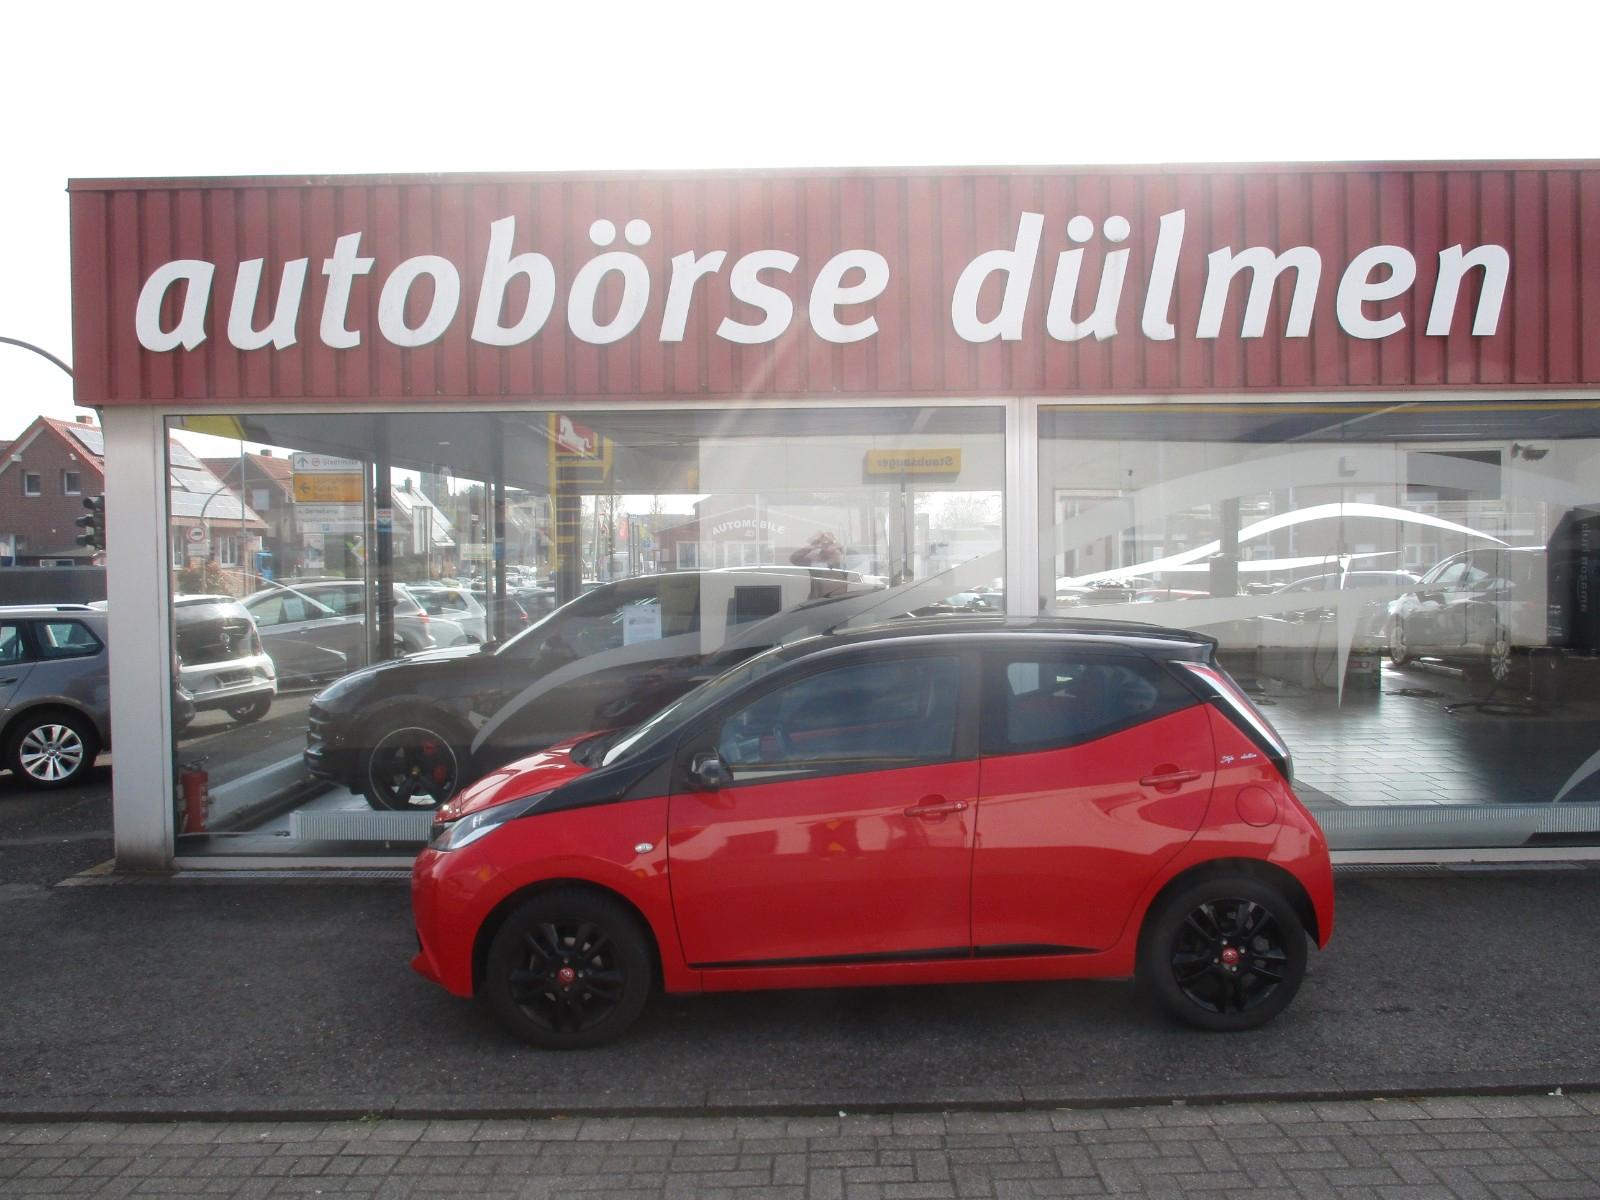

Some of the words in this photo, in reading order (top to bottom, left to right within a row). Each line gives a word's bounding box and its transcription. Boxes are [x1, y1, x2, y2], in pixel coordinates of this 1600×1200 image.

[135, 215, 889, 352] autobörse
[951, 209, 1510, 343] dülmen
[712, 519, 785, 535] AUTOMOBILE
